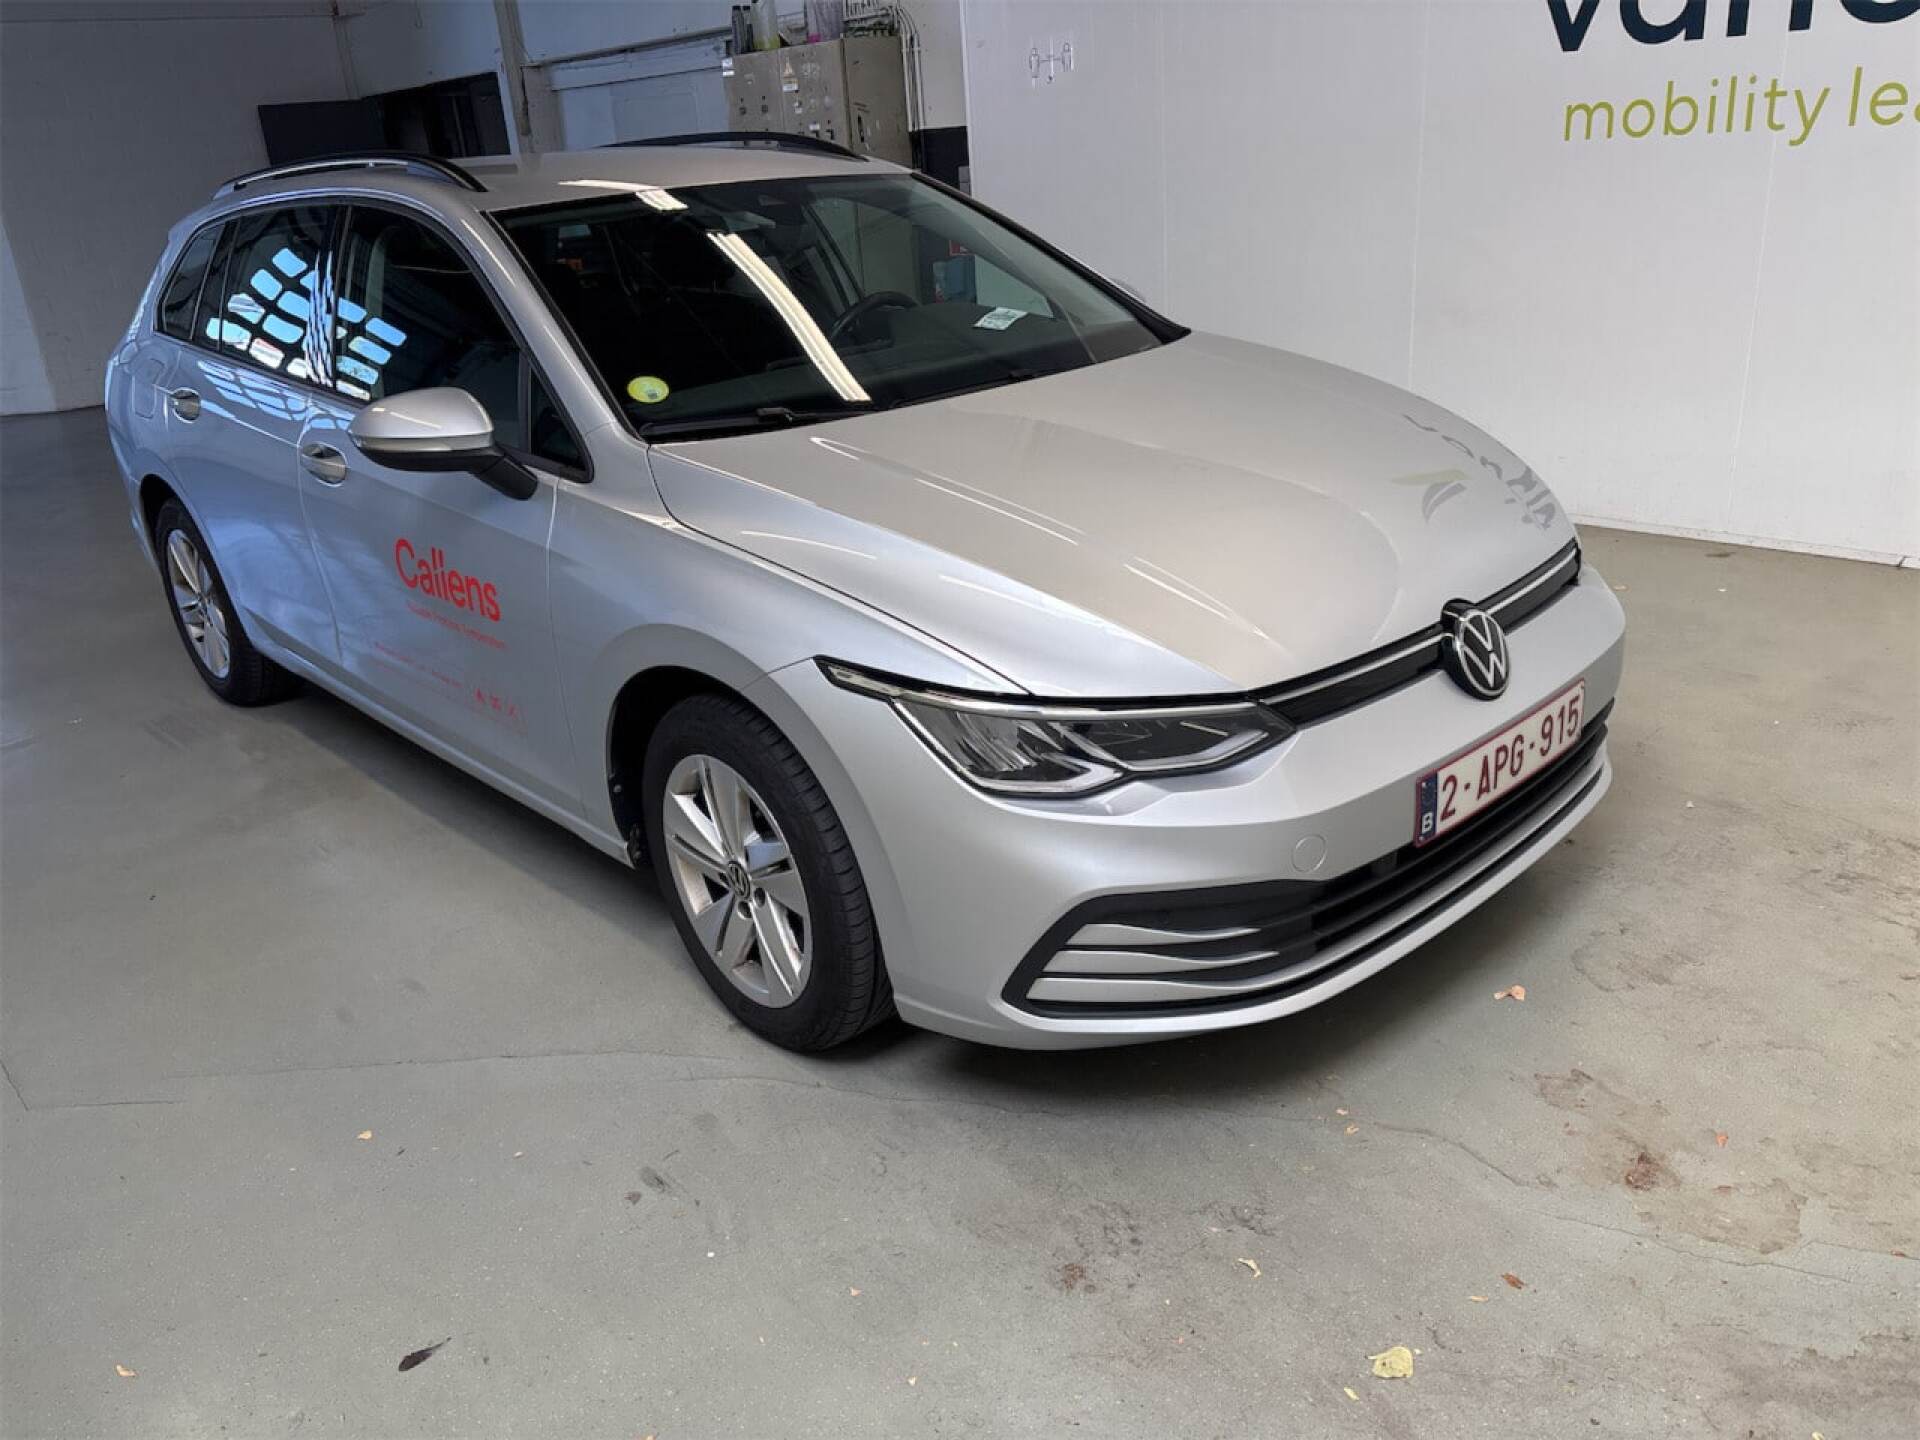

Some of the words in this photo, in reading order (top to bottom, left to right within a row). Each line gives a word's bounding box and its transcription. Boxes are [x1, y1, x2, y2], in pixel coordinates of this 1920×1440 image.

[1563, 75, 1831, 147] mobility
[1847, 66, 1920, 127] le
[394, 538, 501, 622] Callens
[1440, 695, 1580, 822] 2-APG-915
[1420, 811, 1434, 833] B
